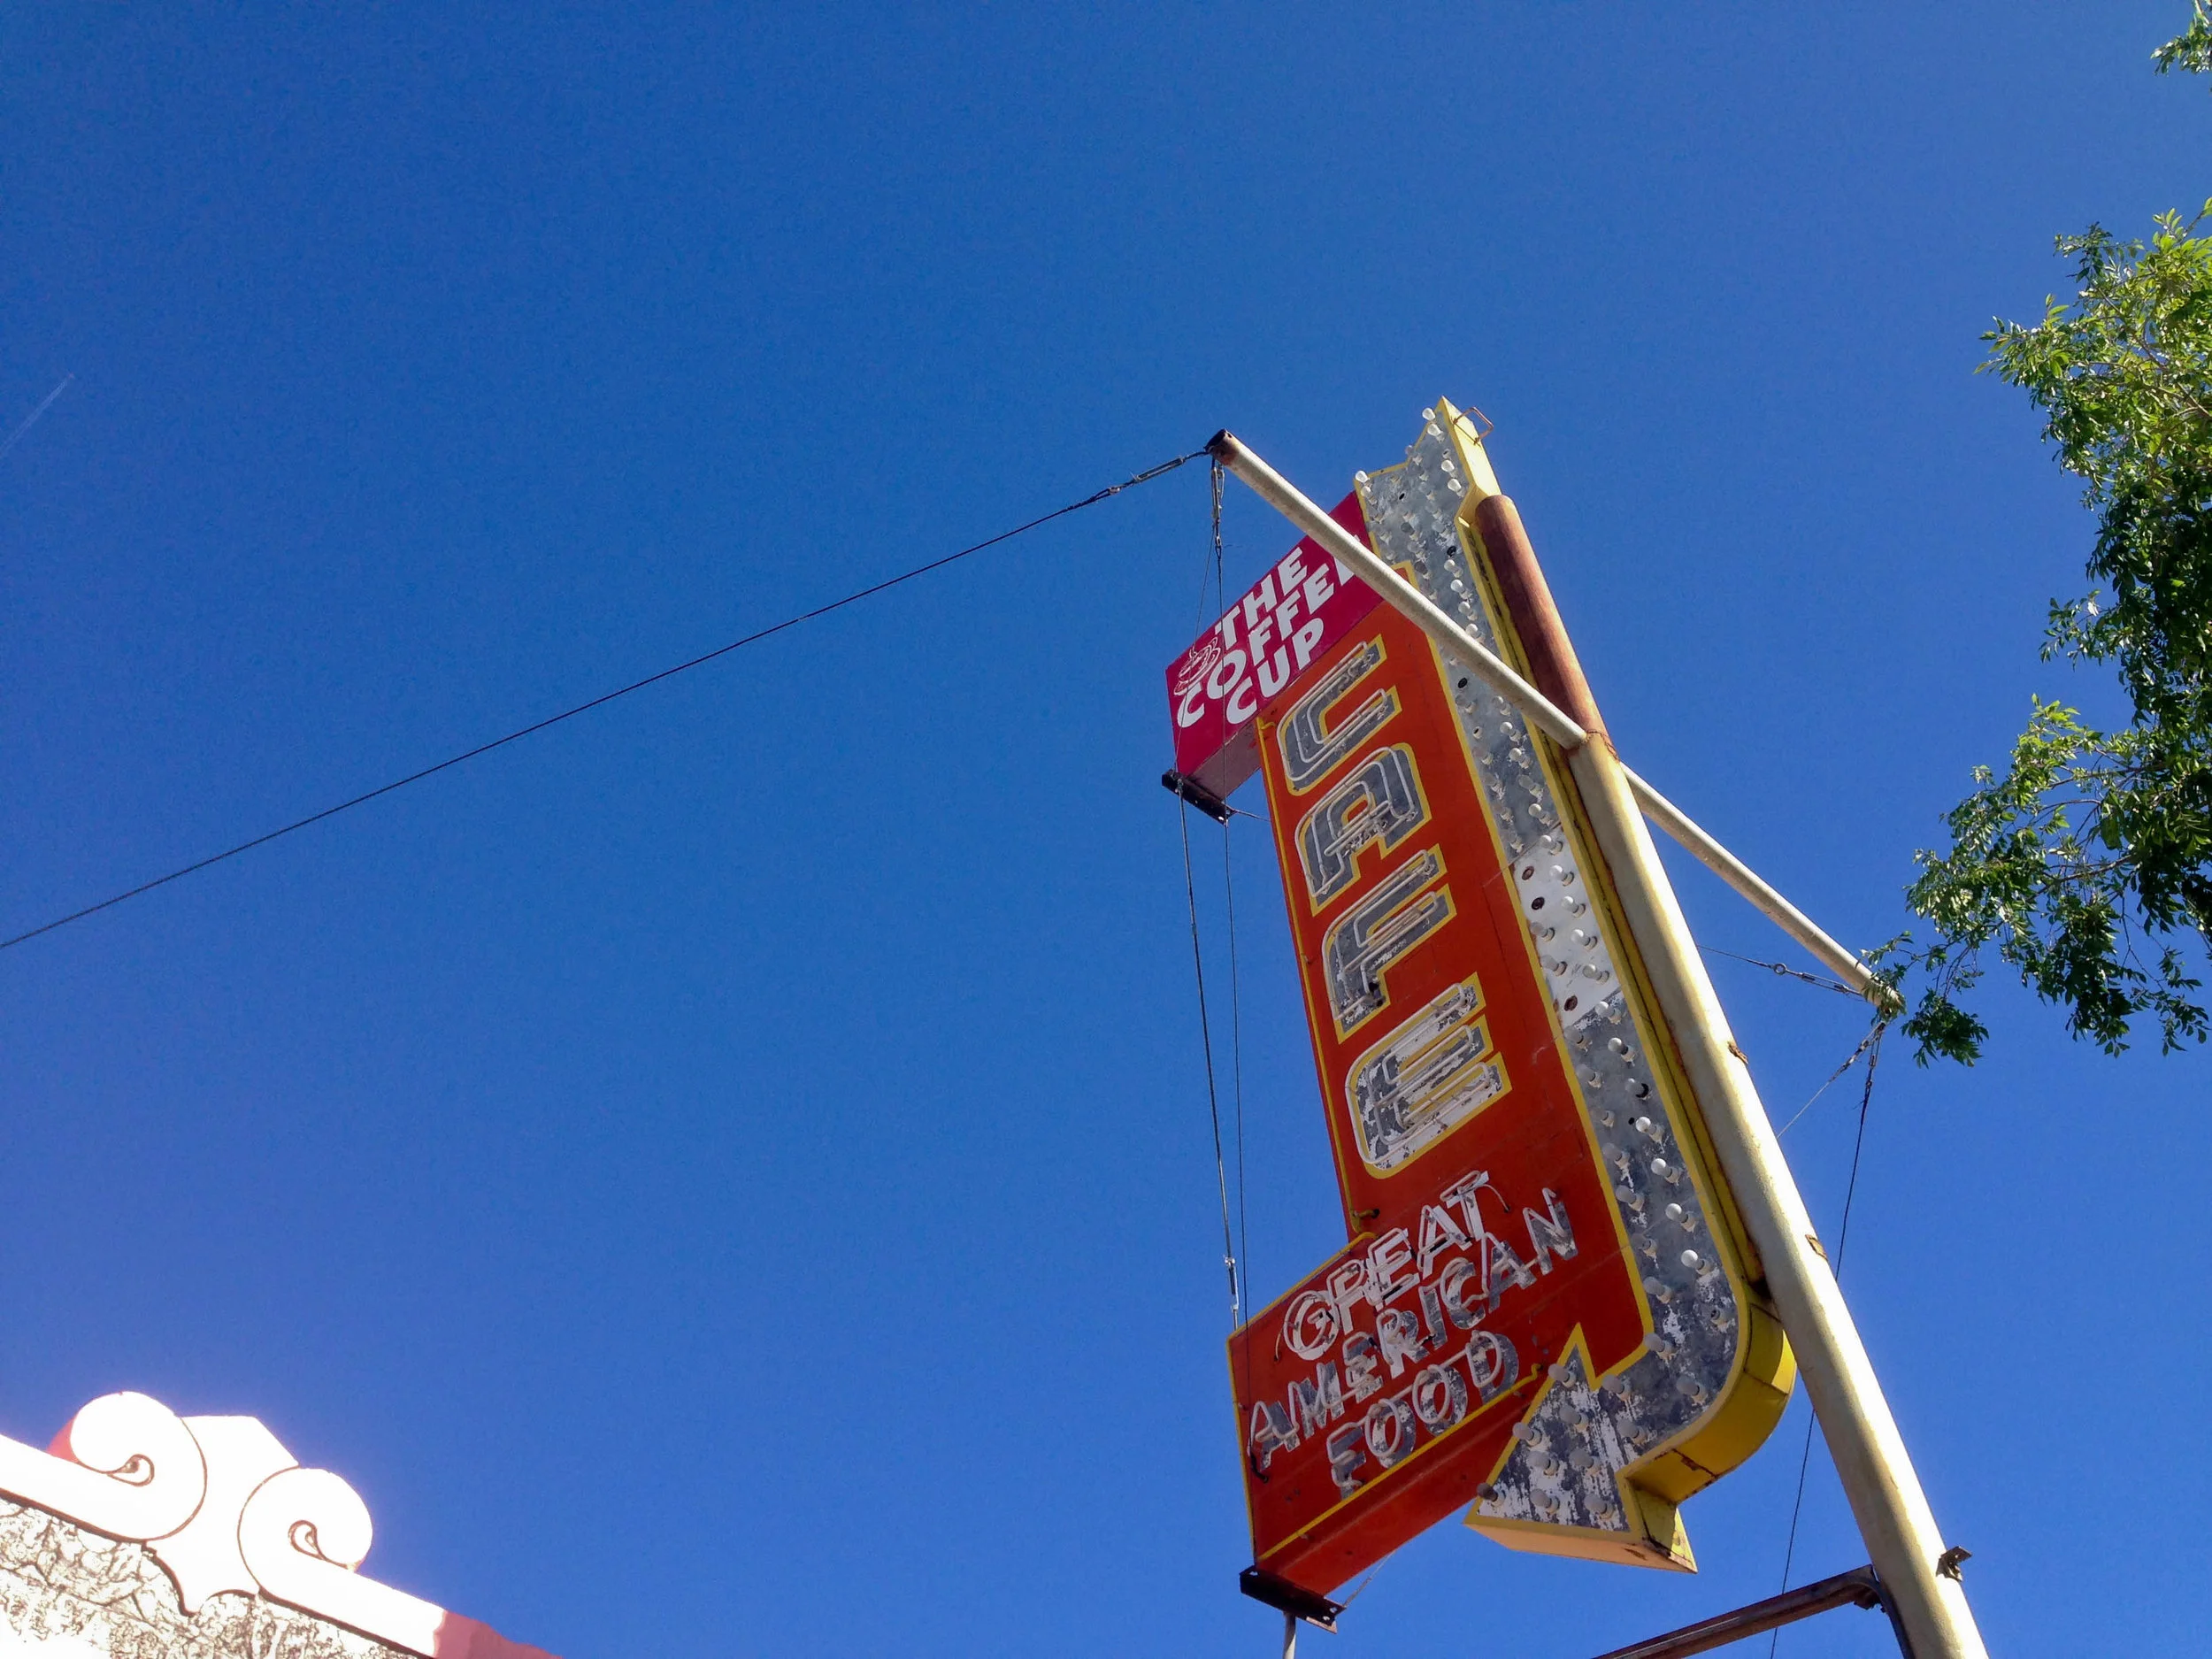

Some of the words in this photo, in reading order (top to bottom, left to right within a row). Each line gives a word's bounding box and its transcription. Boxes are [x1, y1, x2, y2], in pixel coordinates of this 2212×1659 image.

[1215, 547, 1308, 650] THE
[1226, 618, 1325, 725] CUP
[1277, 634, 1512, 1179] CAFE
[1248, 1188, 1578, 1471] AMERICAN
[1284, 1171, 1489, 1361] GREAT
[1326, 1330, 1519, 1500] FOOD
